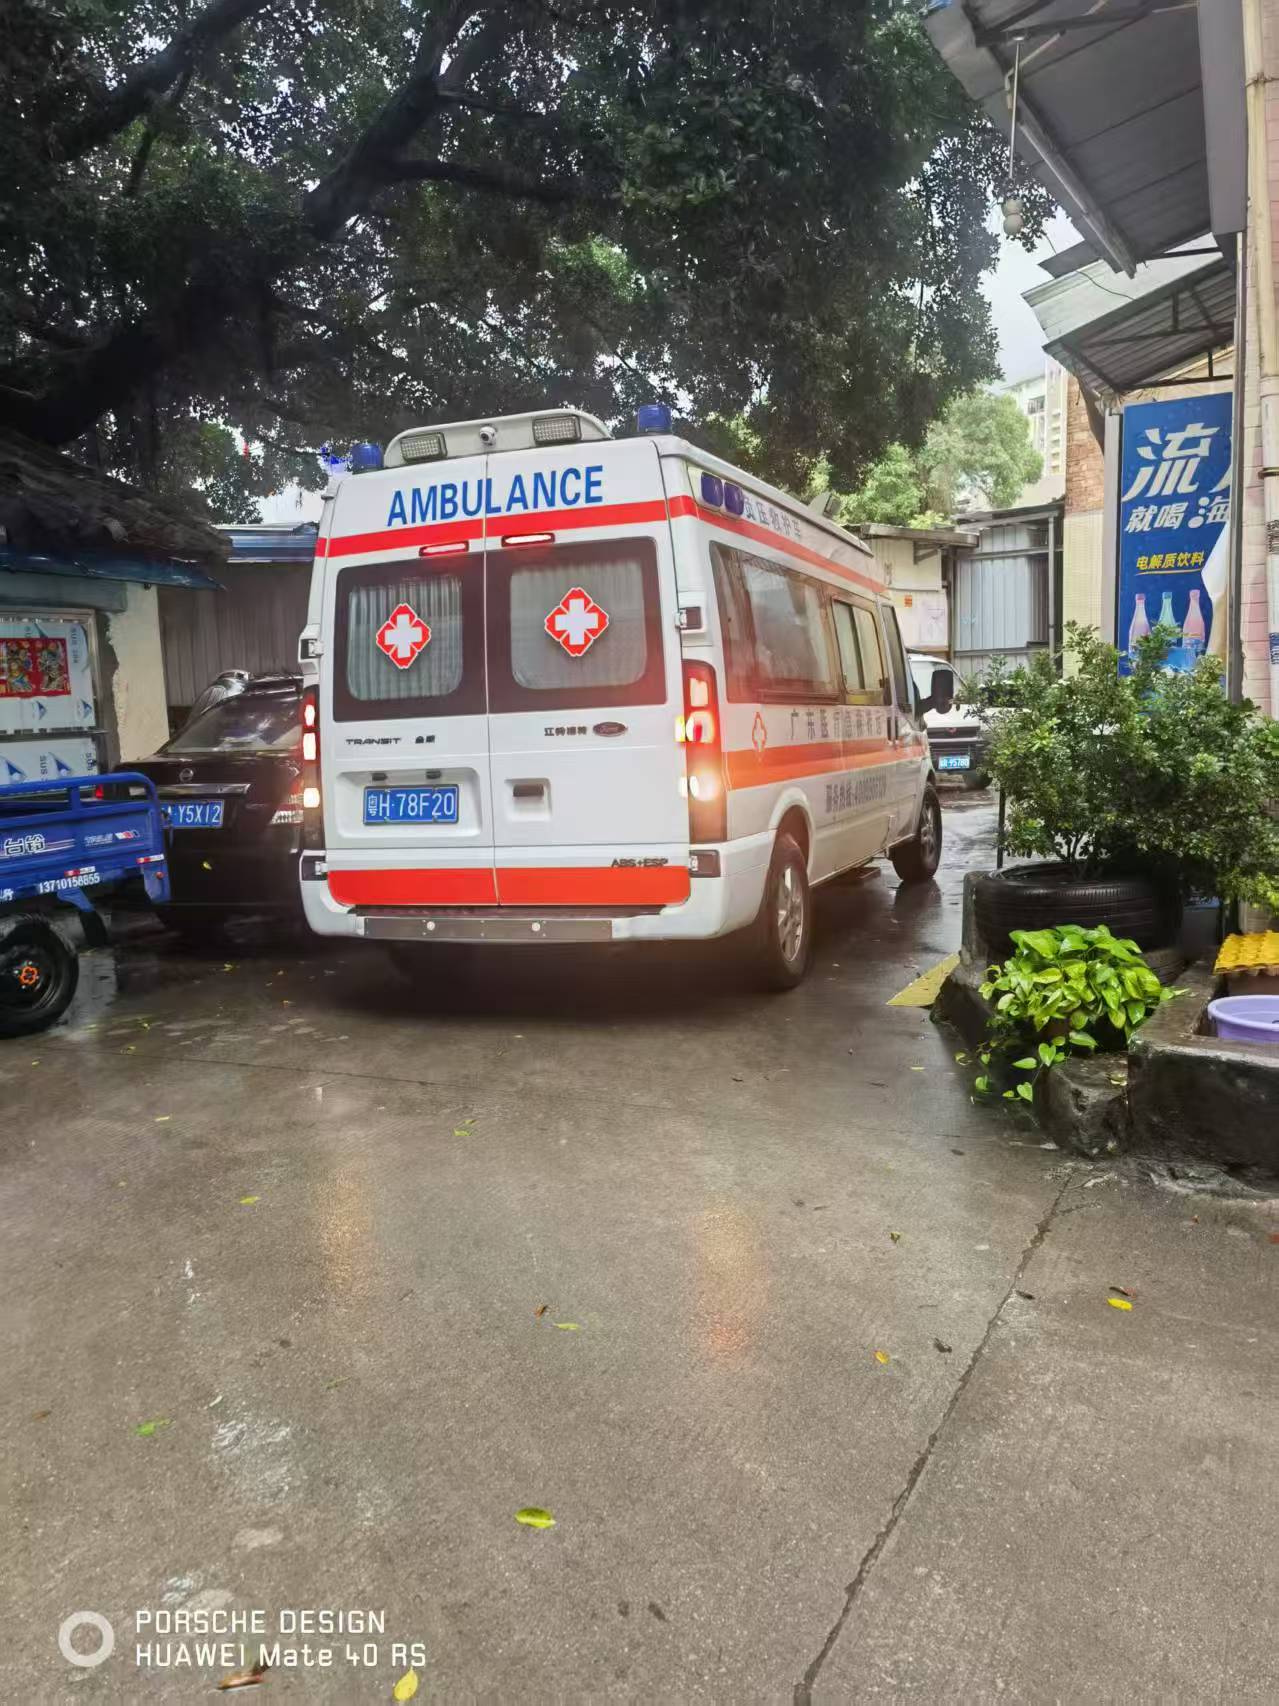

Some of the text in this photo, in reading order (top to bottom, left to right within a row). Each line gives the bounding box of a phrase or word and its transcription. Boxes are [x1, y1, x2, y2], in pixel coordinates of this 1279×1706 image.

[1122, 423, 1232, 502] 流
[387, 465, 603, 527] AMBULANCE
[1136, 552, 1204, 570] 电解质饮料
[346, 737, 401, 745] TRANSIT
[611, 857, 669, 868] ABS+ESP
